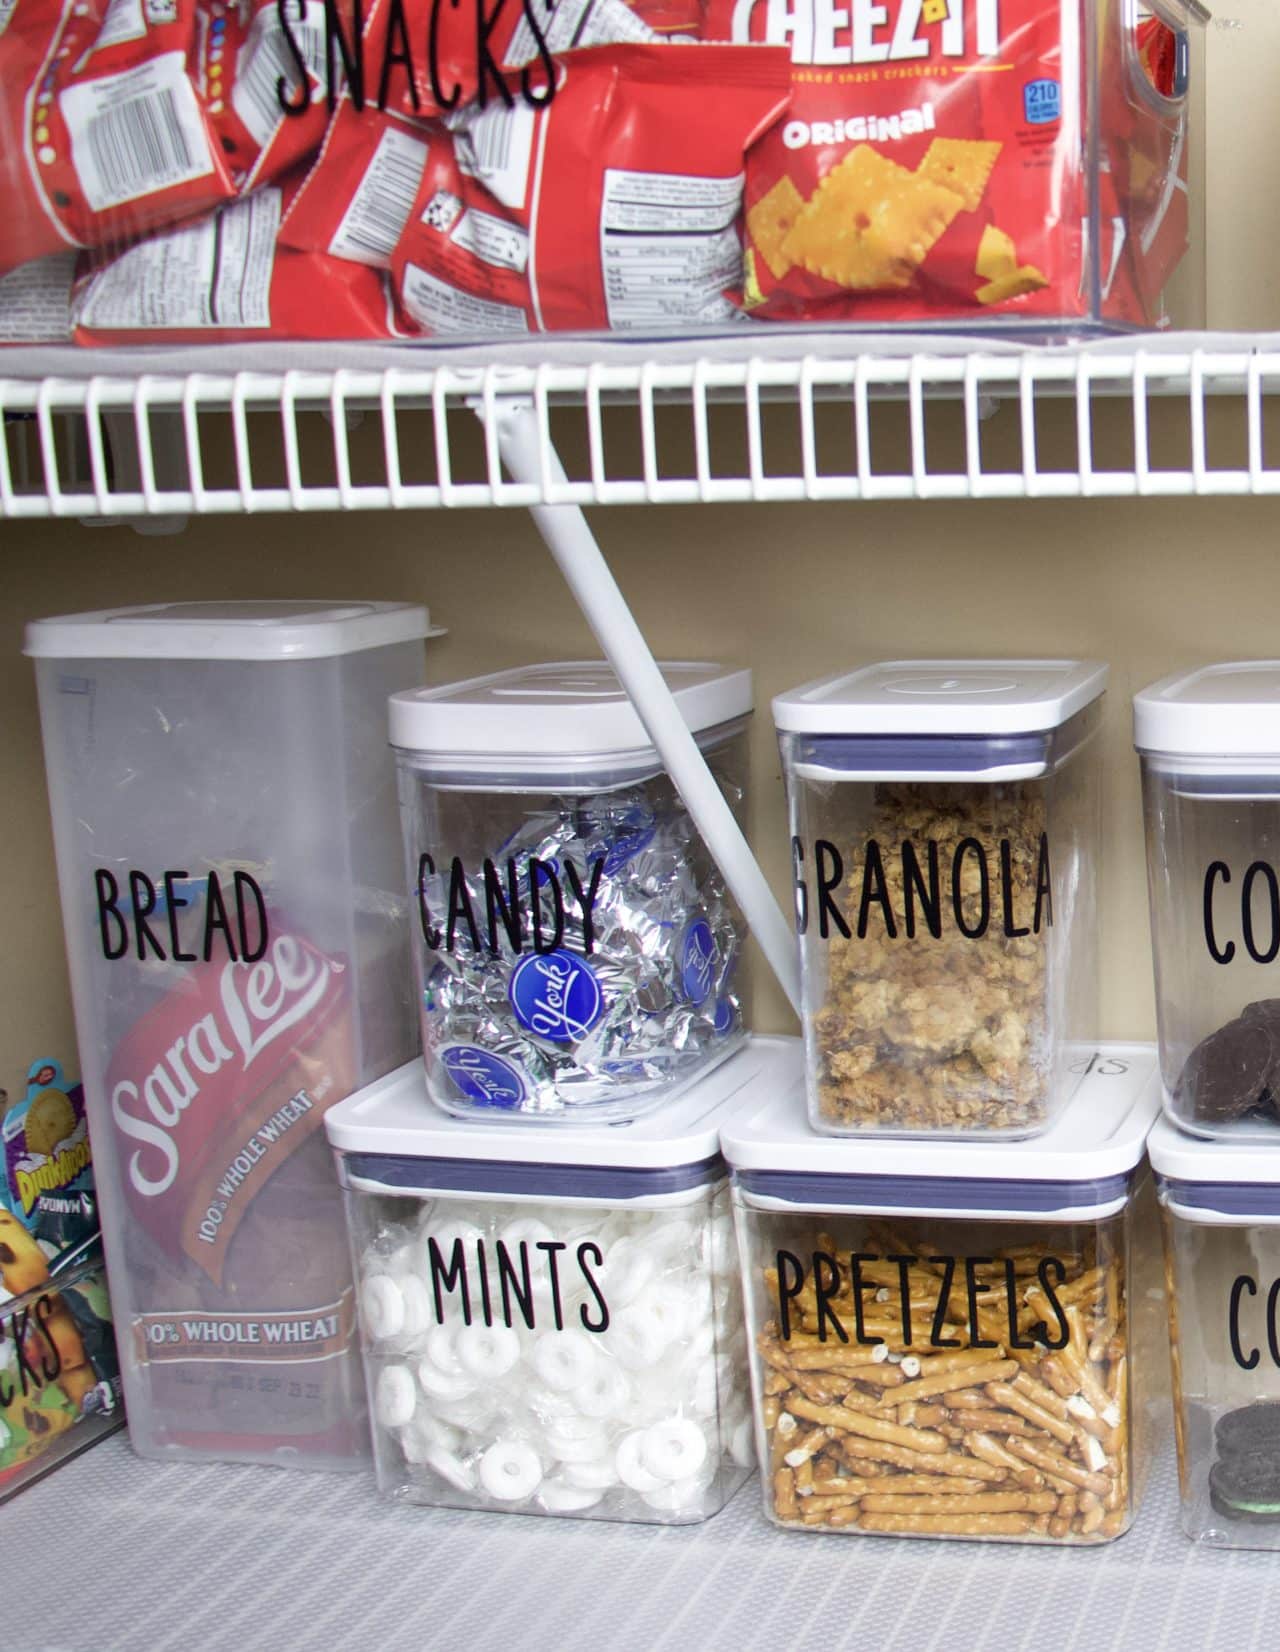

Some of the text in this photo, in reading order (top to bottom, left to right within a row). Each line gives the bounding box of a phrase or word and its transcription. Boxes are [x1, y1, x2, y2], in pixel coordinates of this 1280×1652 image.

[276, 0, 562, 117] SNACKS
[1028, 82, 1057, 103] 210
[95, 868, 270, 962] BREAD
[418, 853, 604, 956] CANDY
[112, 1012, 234, 1196] Sara
[216, 1137, 268, 1199] WHOLE
[256, 1088, 314, 1144] WHEAT
[183, 1320, 260, 1344] WHOLE
[263, 1314, 339, 1344] WHEAT
[428, 1237, 610, 1334] MINTS
[776, 1250, 1071, 1350] PRETZELS
